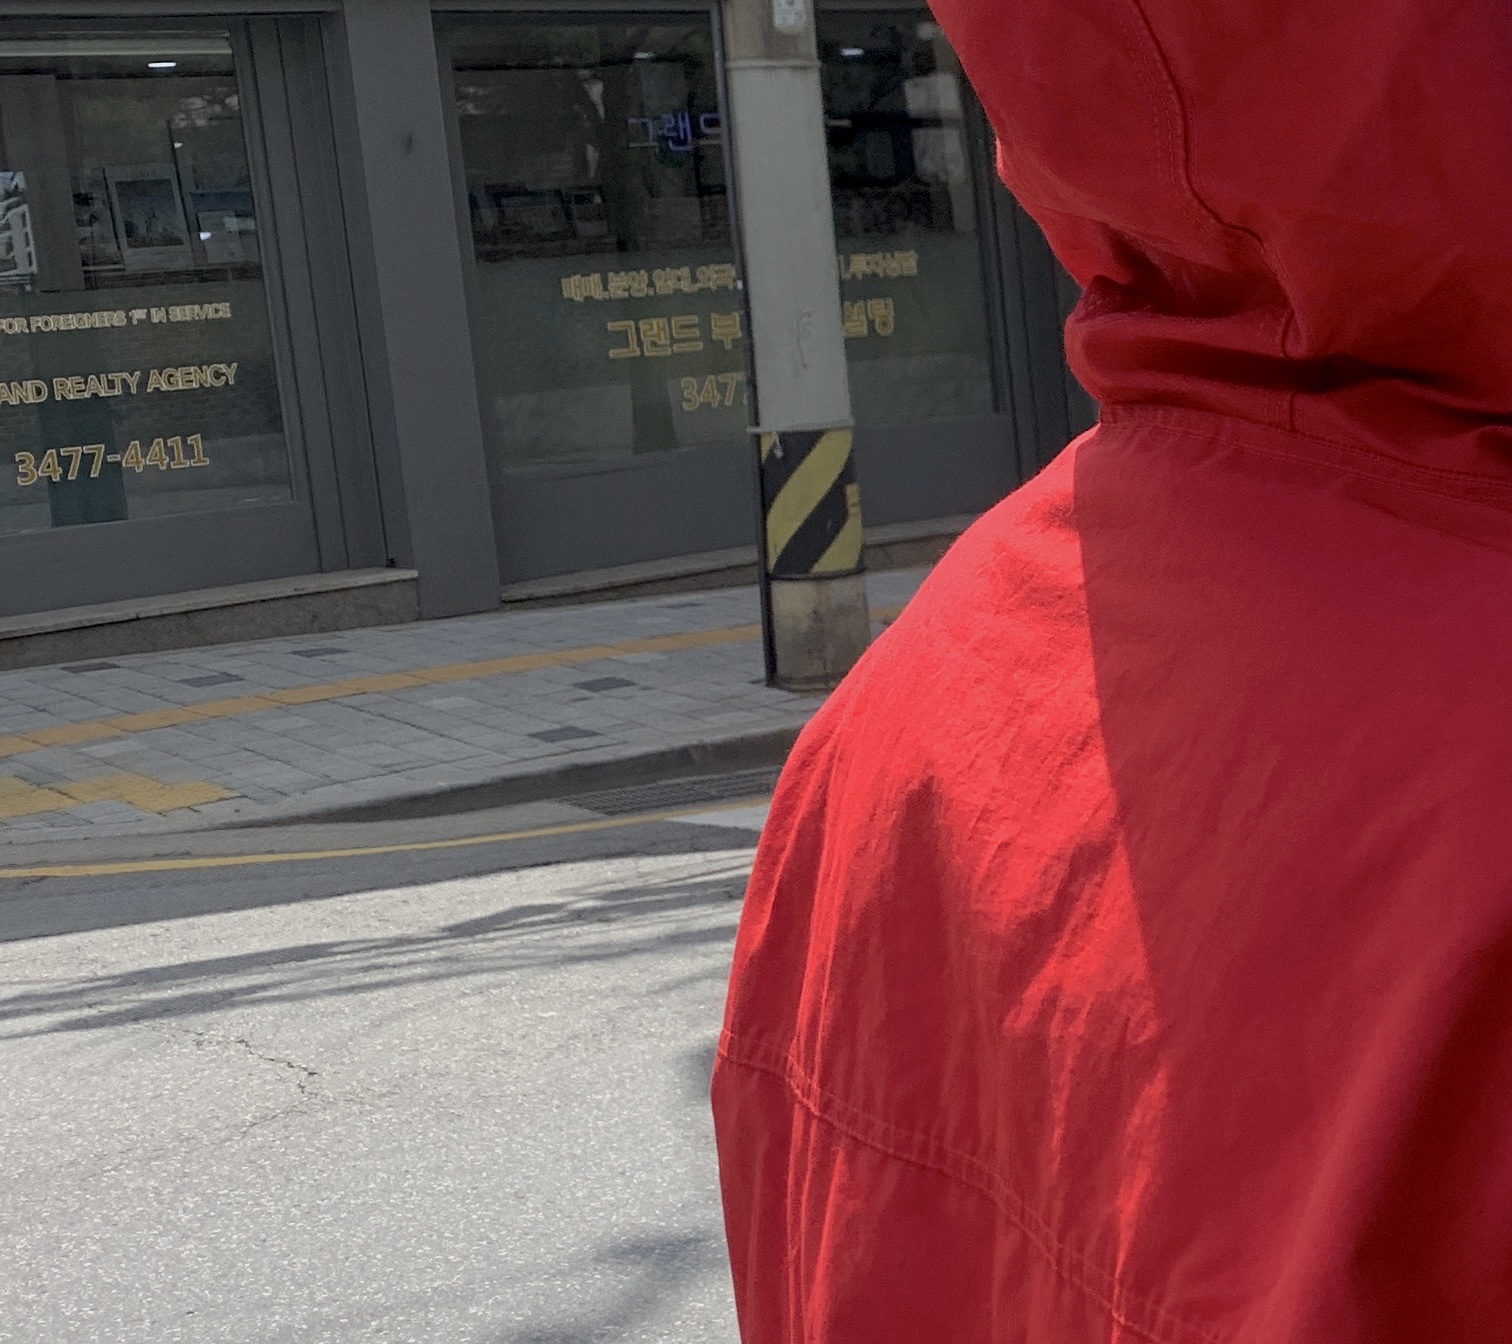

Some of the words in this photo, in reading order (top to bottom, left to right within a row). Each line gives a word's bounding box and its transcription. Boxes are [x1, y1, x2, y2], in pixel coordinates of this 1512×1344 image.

[30, 309, 127, 333] FOREIGNERS
[150, 307, 166, 323] IN
[168, 302, 231, 322] SERVICE
[607, 314, 703, 358] 그랜드
[710, 311, 742, 350] 부
[0, 379, 48, 405] AND
[53, 370, 141, 401] REALTY
[146, 362, 238, 393] AGENCY
[15, 433, 209, 486] 3477-4411
